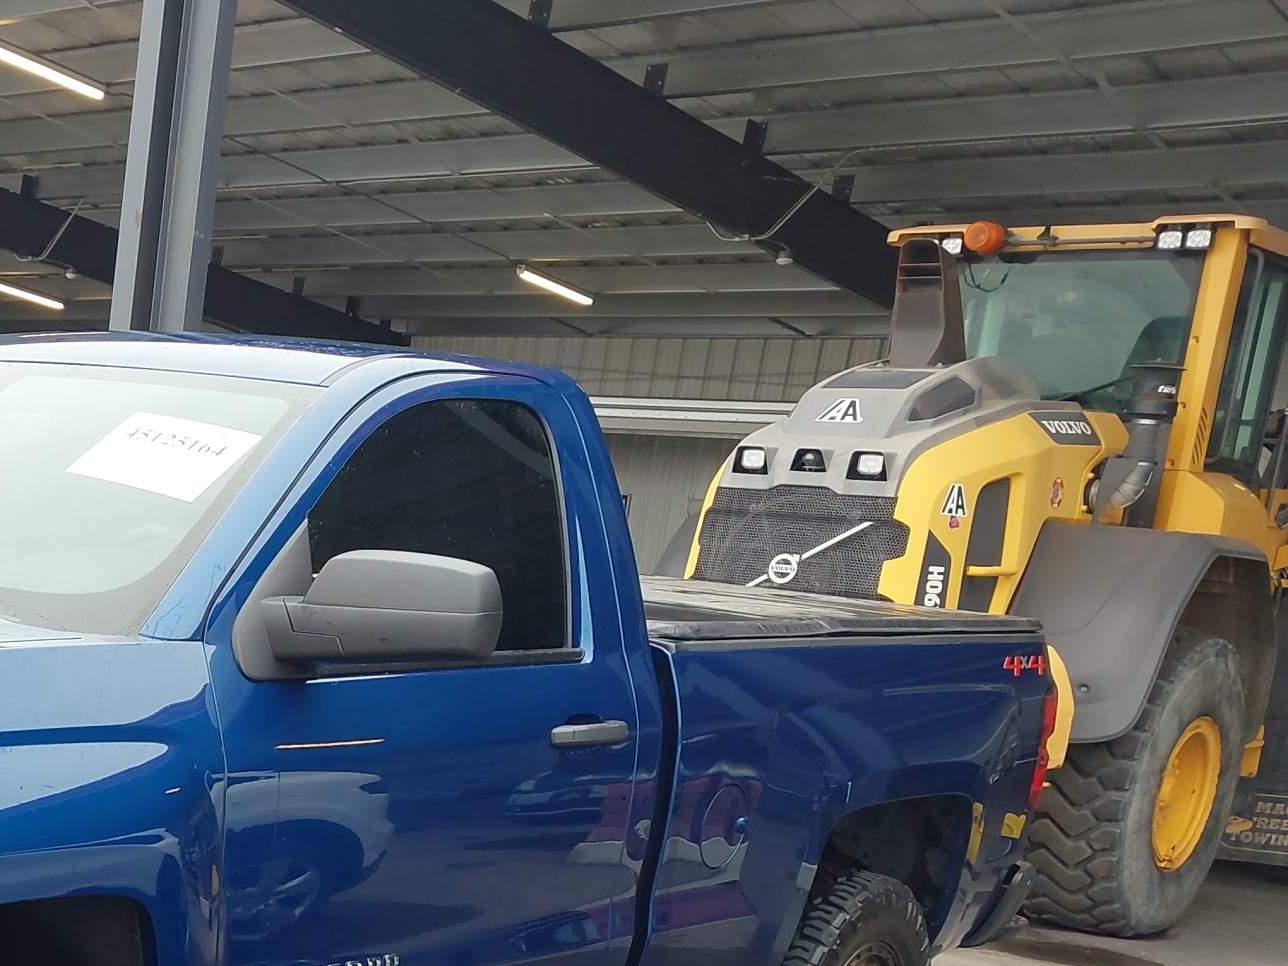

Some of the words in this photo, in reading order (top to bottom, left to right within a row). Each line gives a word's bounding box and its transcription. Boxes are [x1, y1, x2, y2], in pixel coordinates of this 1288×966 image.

[125, 427, 228, 456] 45125164
[1040, 420, 1092, 435] VOLVO
[924, 565, 945, 609] 90H
